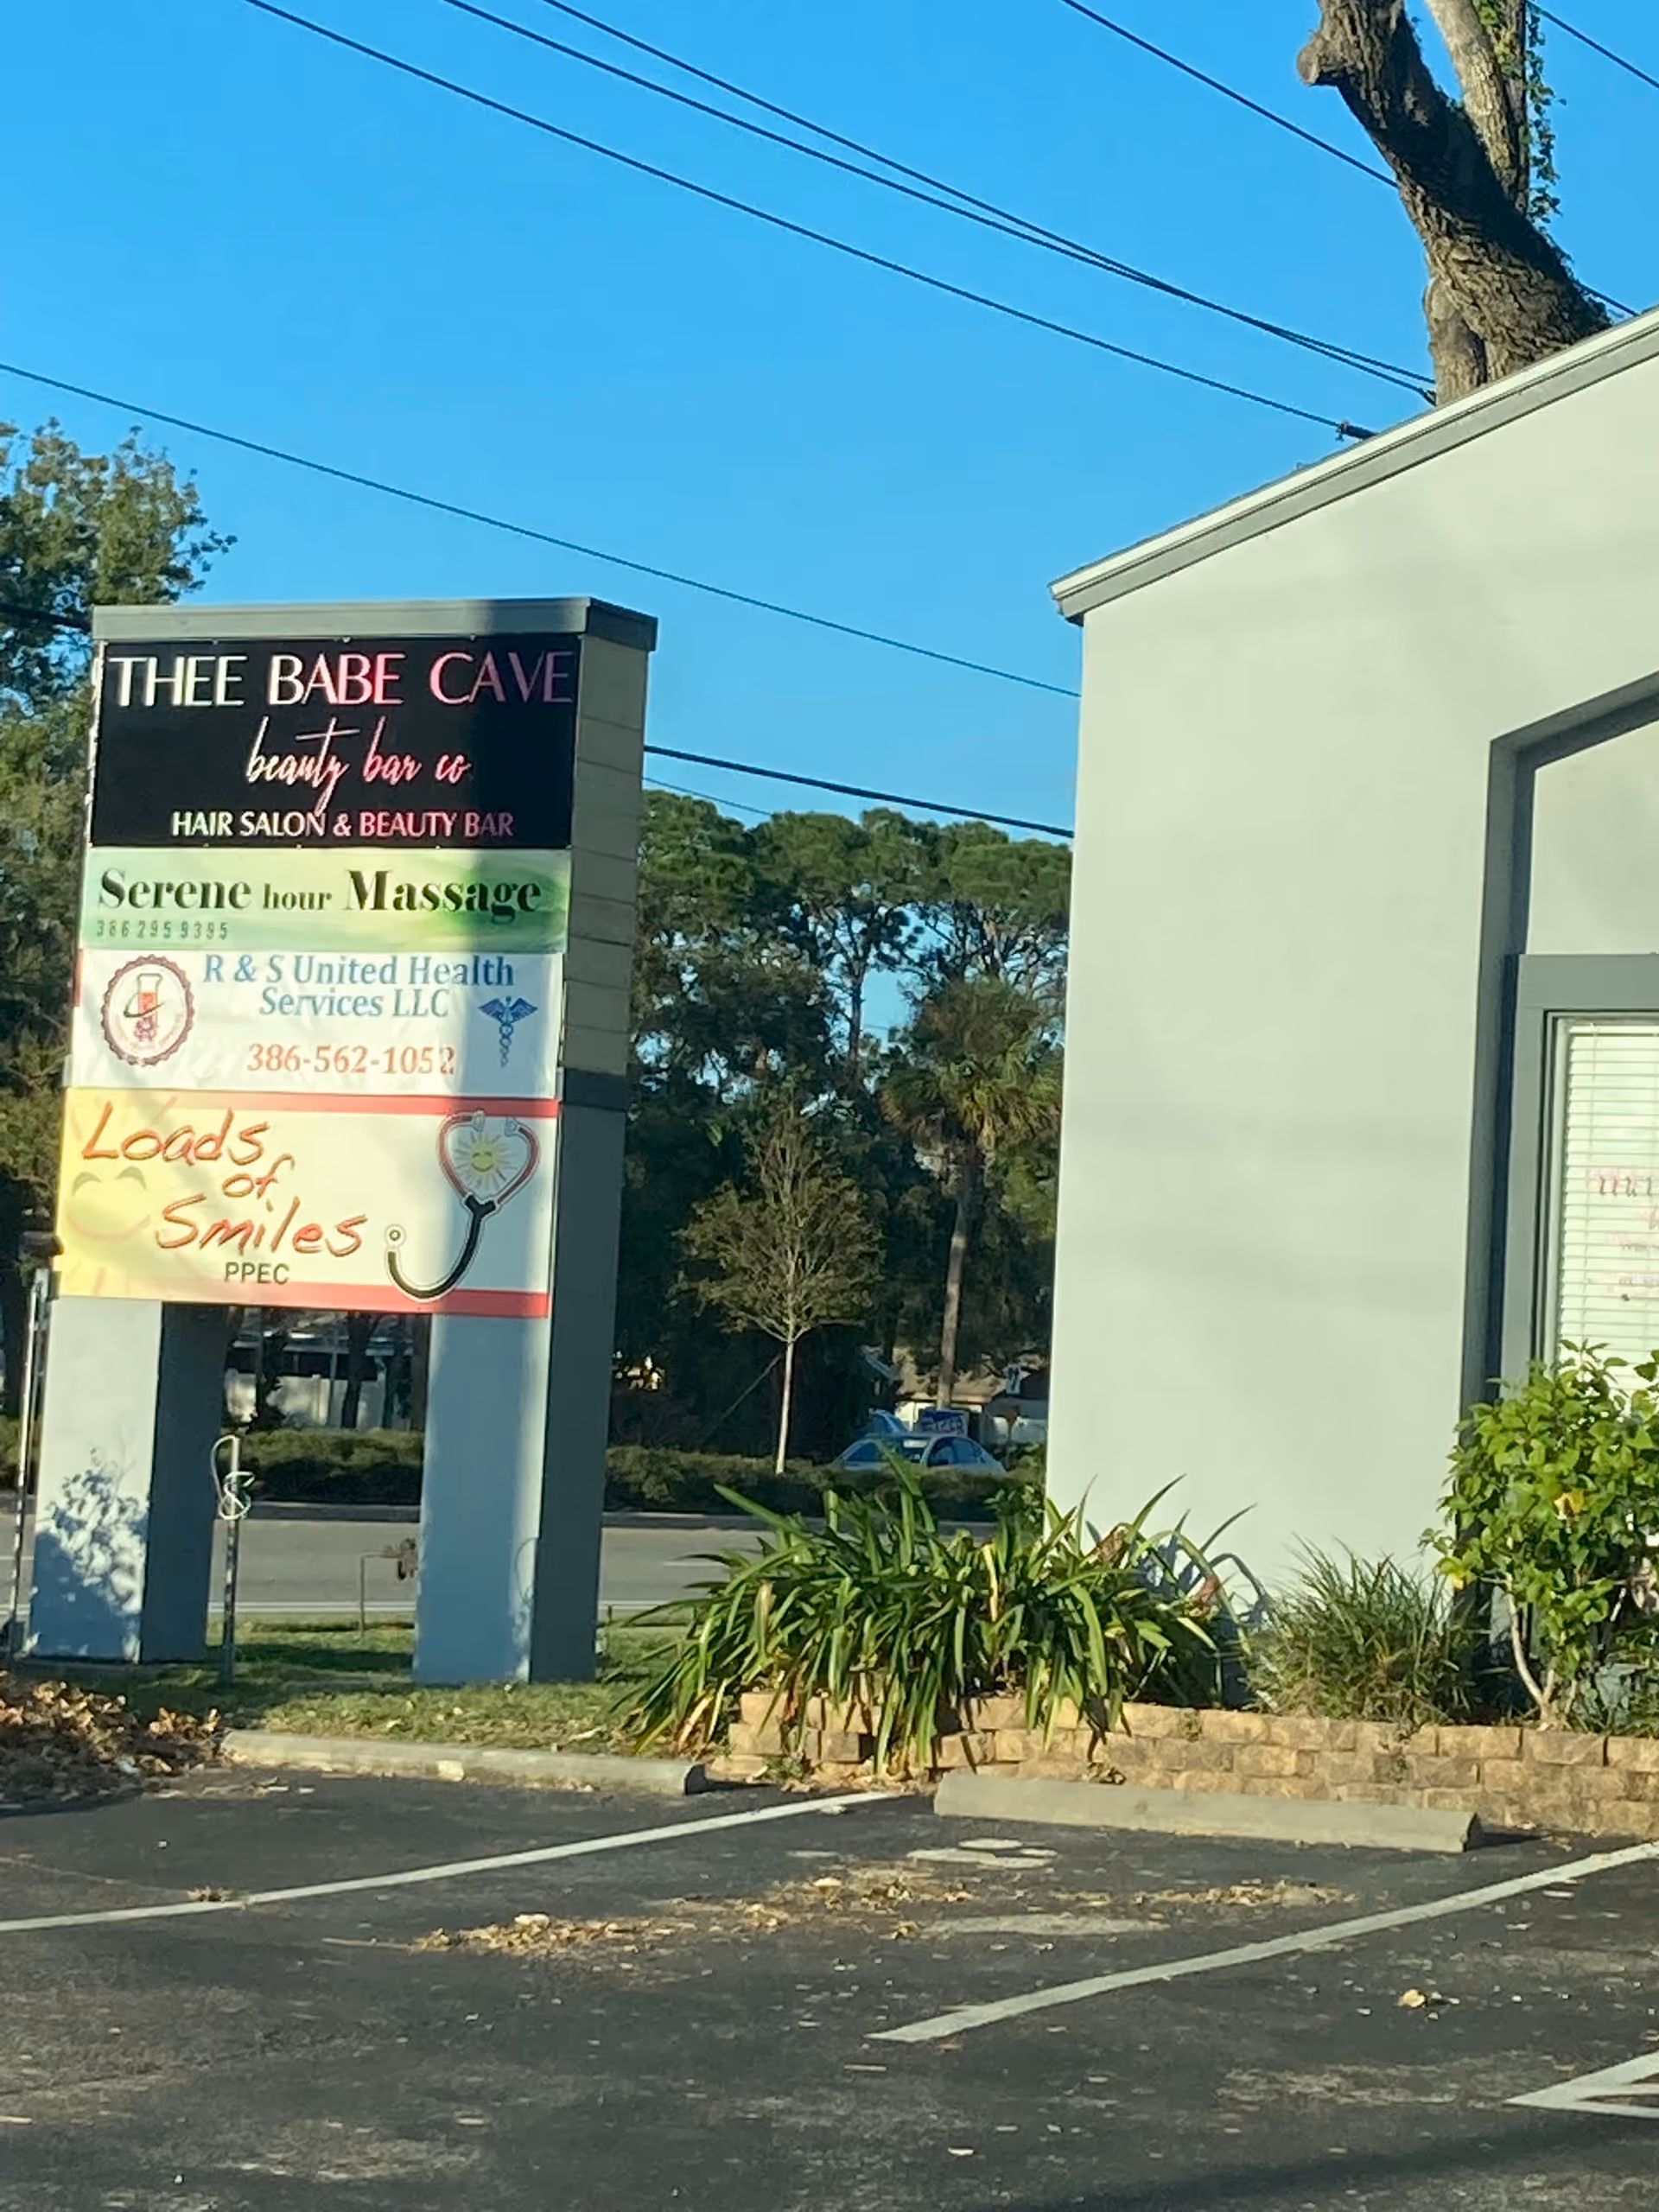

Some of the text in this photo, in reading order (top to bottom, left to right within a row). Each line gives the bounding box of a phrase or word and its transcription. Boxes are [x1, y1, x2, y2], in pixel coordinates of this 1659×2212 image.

[108, 650, 575, 708] THEE BABE CAVE
[245, 715, 470, 817] beauty bar co
[172, 810, 514, 837] HAIR SALON & BEAUTY BAR
[99, 868, 542, 924] Serene hour Massage
[137, 919, 172, 939] 295
[181, 920, 228, 941] 9395
[203, 954, 515, 987] R & S United Health
[259, 988, 450, 1018] Services LLC
[246, 1042, 456, 1075] 386-562-1052
[80, 1100, 270, 1166] Loads
[222, 1153, 296, 1200] of
[154, 1192, 367, 1258] Smiles
[224, 1262, 290, 1285] PPEC
